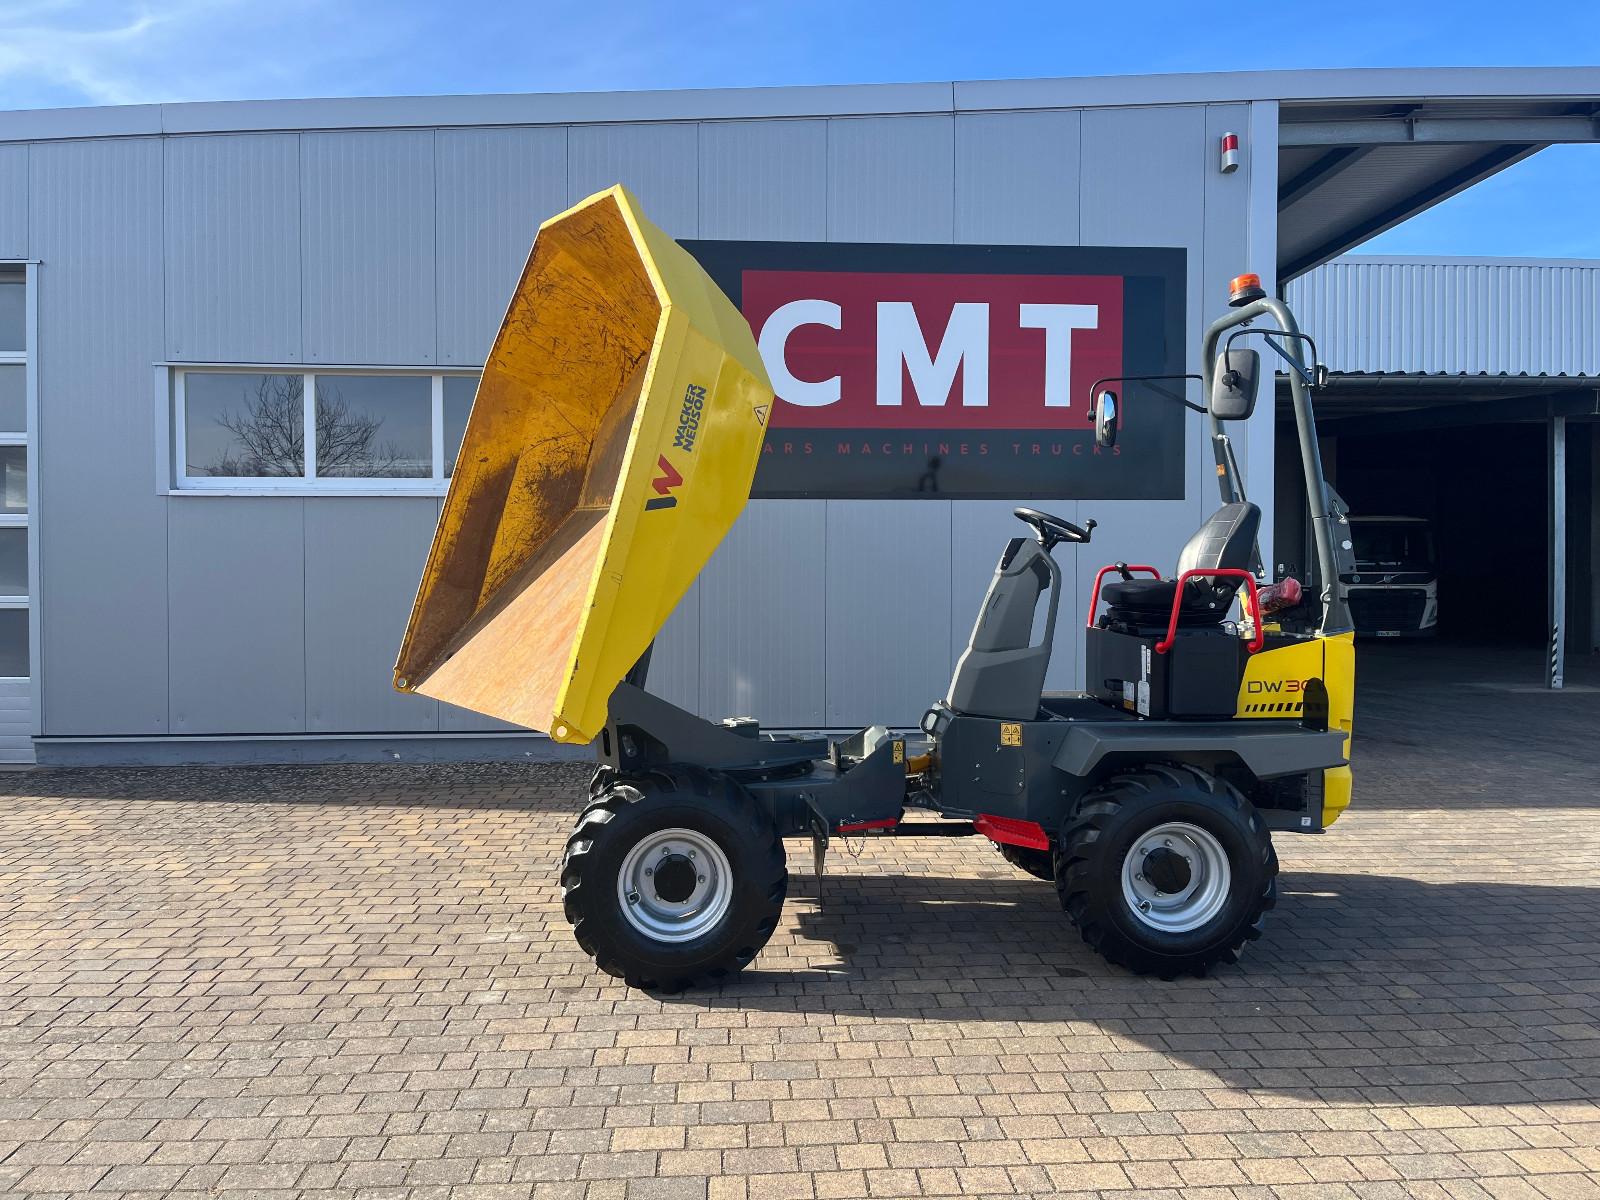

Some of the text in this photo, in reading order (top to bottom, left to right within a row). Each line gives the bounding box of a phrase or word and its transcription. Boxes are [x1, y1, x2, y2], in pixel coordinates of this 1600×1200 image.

[757, 299, 1099, 407] CMT
[672, 383, 695, 447] WACKER
[682, 385, 707, 453] NEUSON
[763, 443, 1121, 456] ARS MACHINES TRUCKS
